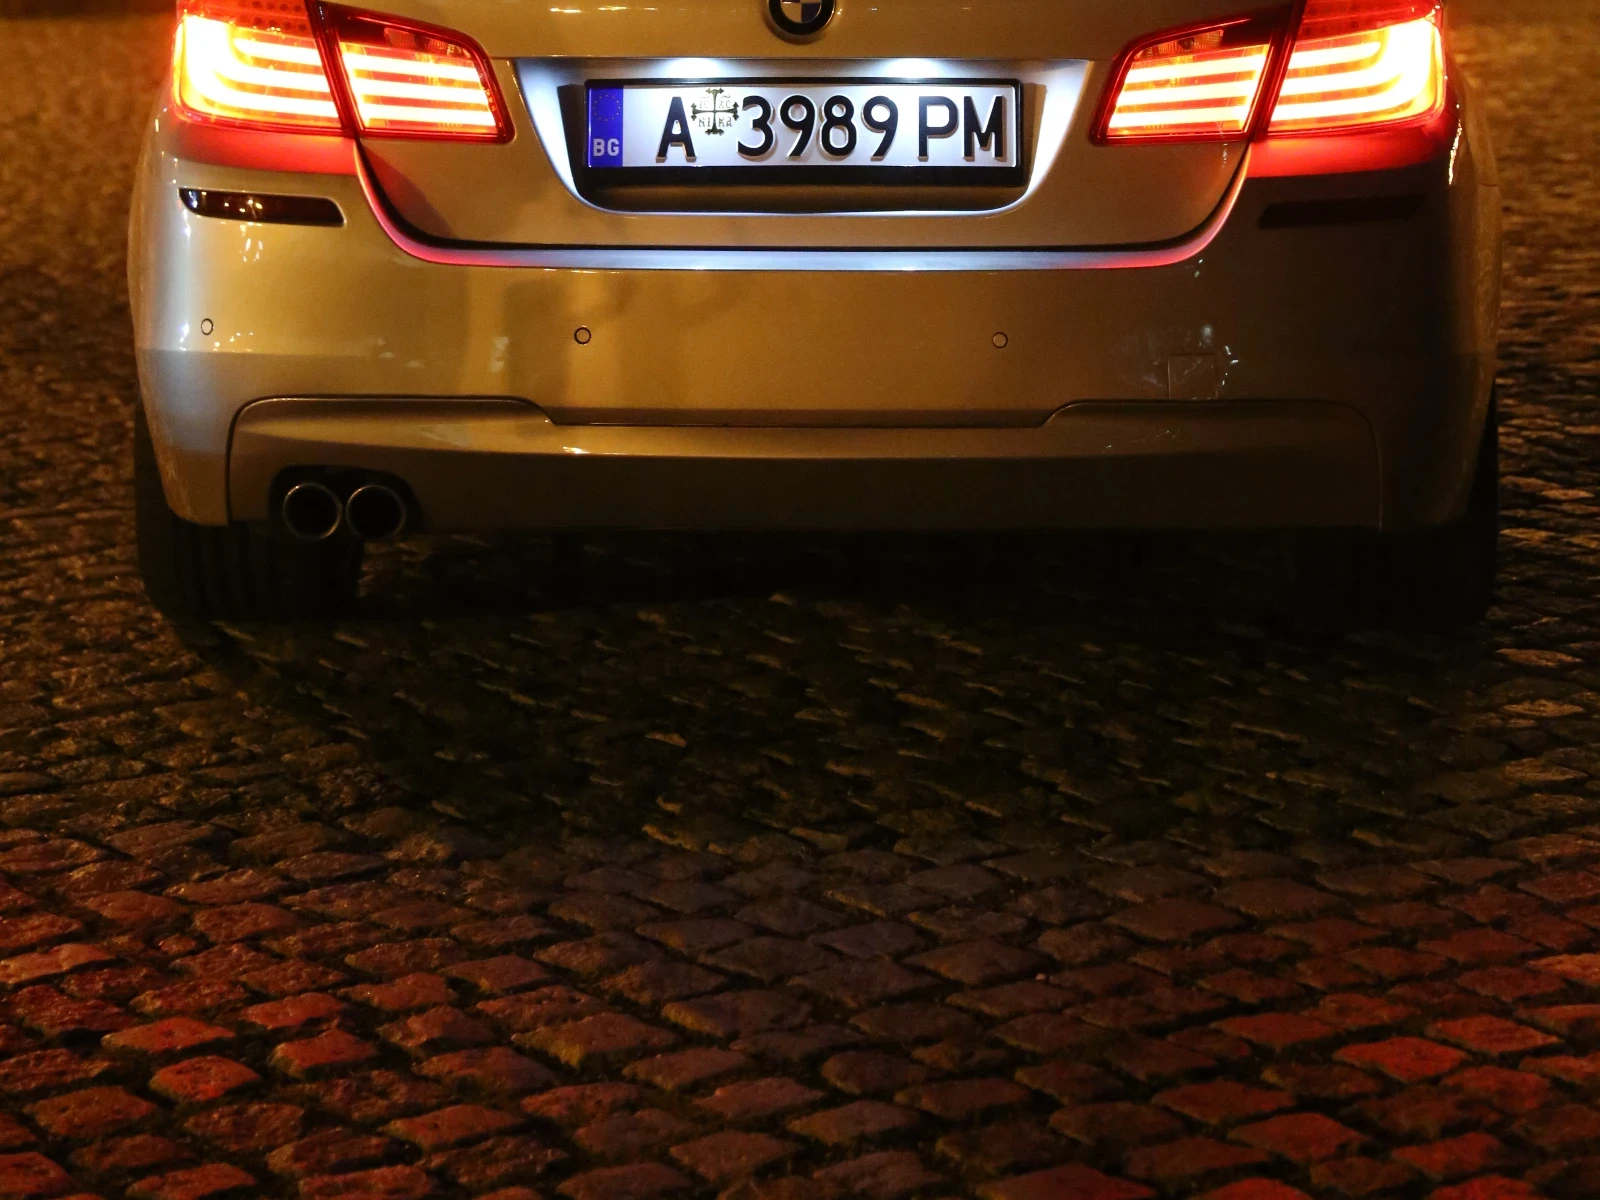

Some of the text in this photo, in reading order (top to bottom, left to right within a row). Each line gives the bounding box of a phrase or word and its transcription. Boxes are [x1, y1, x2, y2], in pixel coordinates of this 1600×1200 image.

[593, 138, 619, 157] BG
[656, 95, 1005, 161] A 3989 PM
